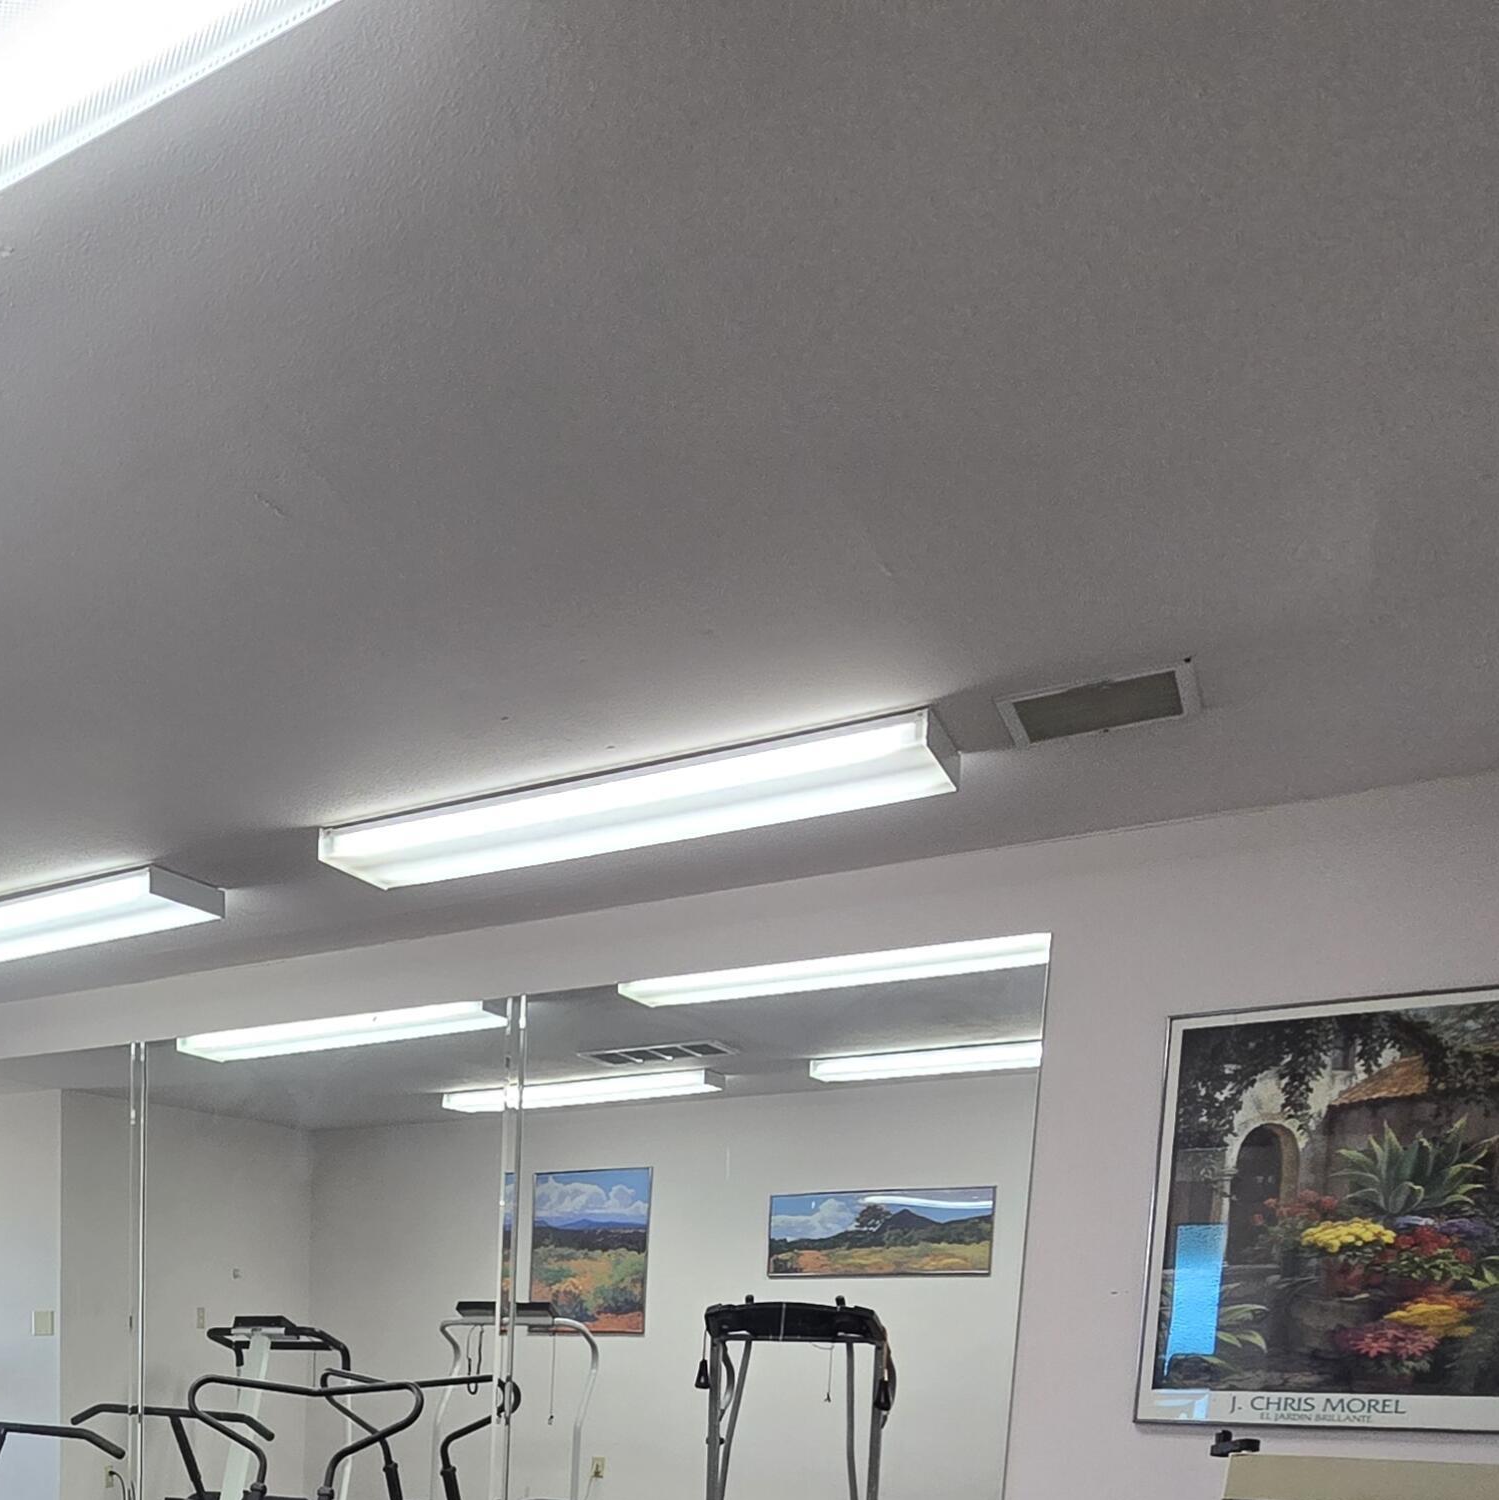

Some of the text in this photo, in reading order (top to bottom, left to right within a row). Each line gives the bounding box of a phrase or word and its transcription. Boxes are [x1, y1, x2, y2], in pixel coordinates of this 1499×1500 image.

[1229, 1395, 1407, 1414] J. CHRIS MOREL
[1259, 1412, 1373, 1424] EL JARDIN BRILLANTE
